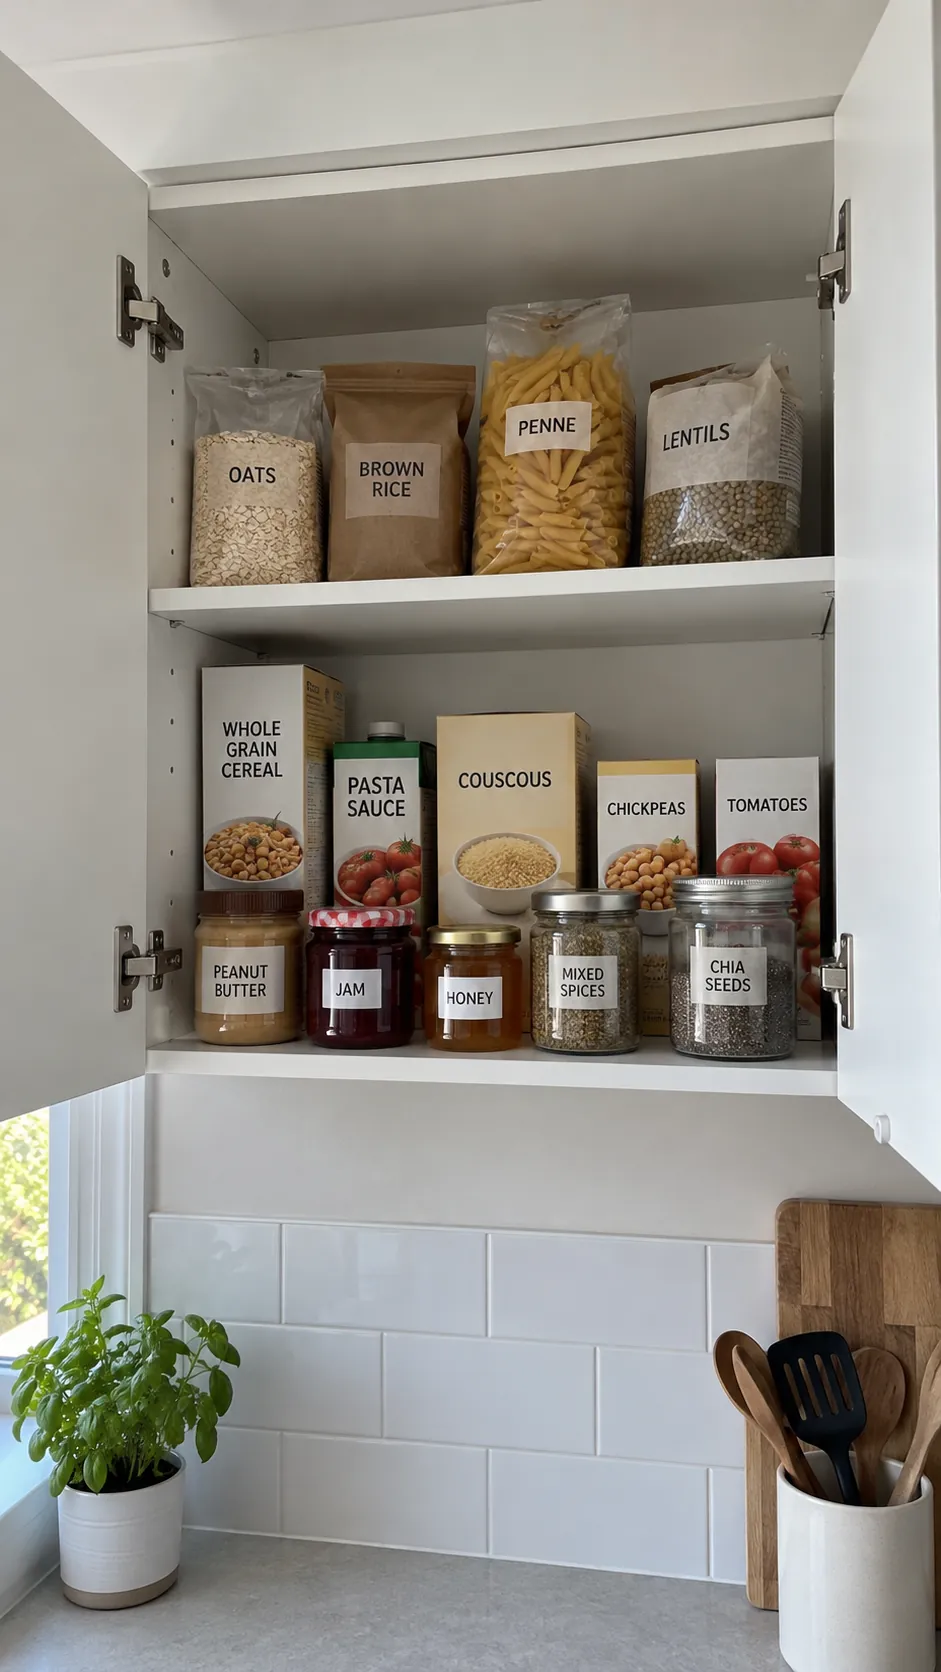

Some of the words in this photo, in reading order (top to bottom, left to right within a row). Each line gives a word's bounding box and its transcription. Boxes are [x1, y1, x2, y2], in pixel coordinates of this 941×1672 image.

[519, 417, 576, 436] PENNE
[663, 422, 730, 452] LENTILS
[229, 466, 276, 484] OATS
[359, 461, 424, 478] BROWN
[373, 482, 410, 497] RICE
[223, 721, 280, 736] WHOLE
[227, 742, 276, 757] GRAIN
[222, 762, 282, 778] CEREAL
[349, 777, 404, 794] PASTA
[459, 771, 551, 788] COUSCOUS
[348, 800, 405, 817] SAUCE
[608, 802, 685, 815] CHICKPEAS
[728, 798, 807, 812] TOMATOES
[215, 965, 268, 978] PEANUT
[563, 968, 603, 980] MIXED
[711, 960, 744, 973] CHIA
[216, 984, 266, 997] BUTTER
[336, 983, 364, 996] JAM
[561, 984, 605, 997] SPICES
[706, 978, 750, 992] SEEDS
[447, 991, 493, 1005] HONEY
